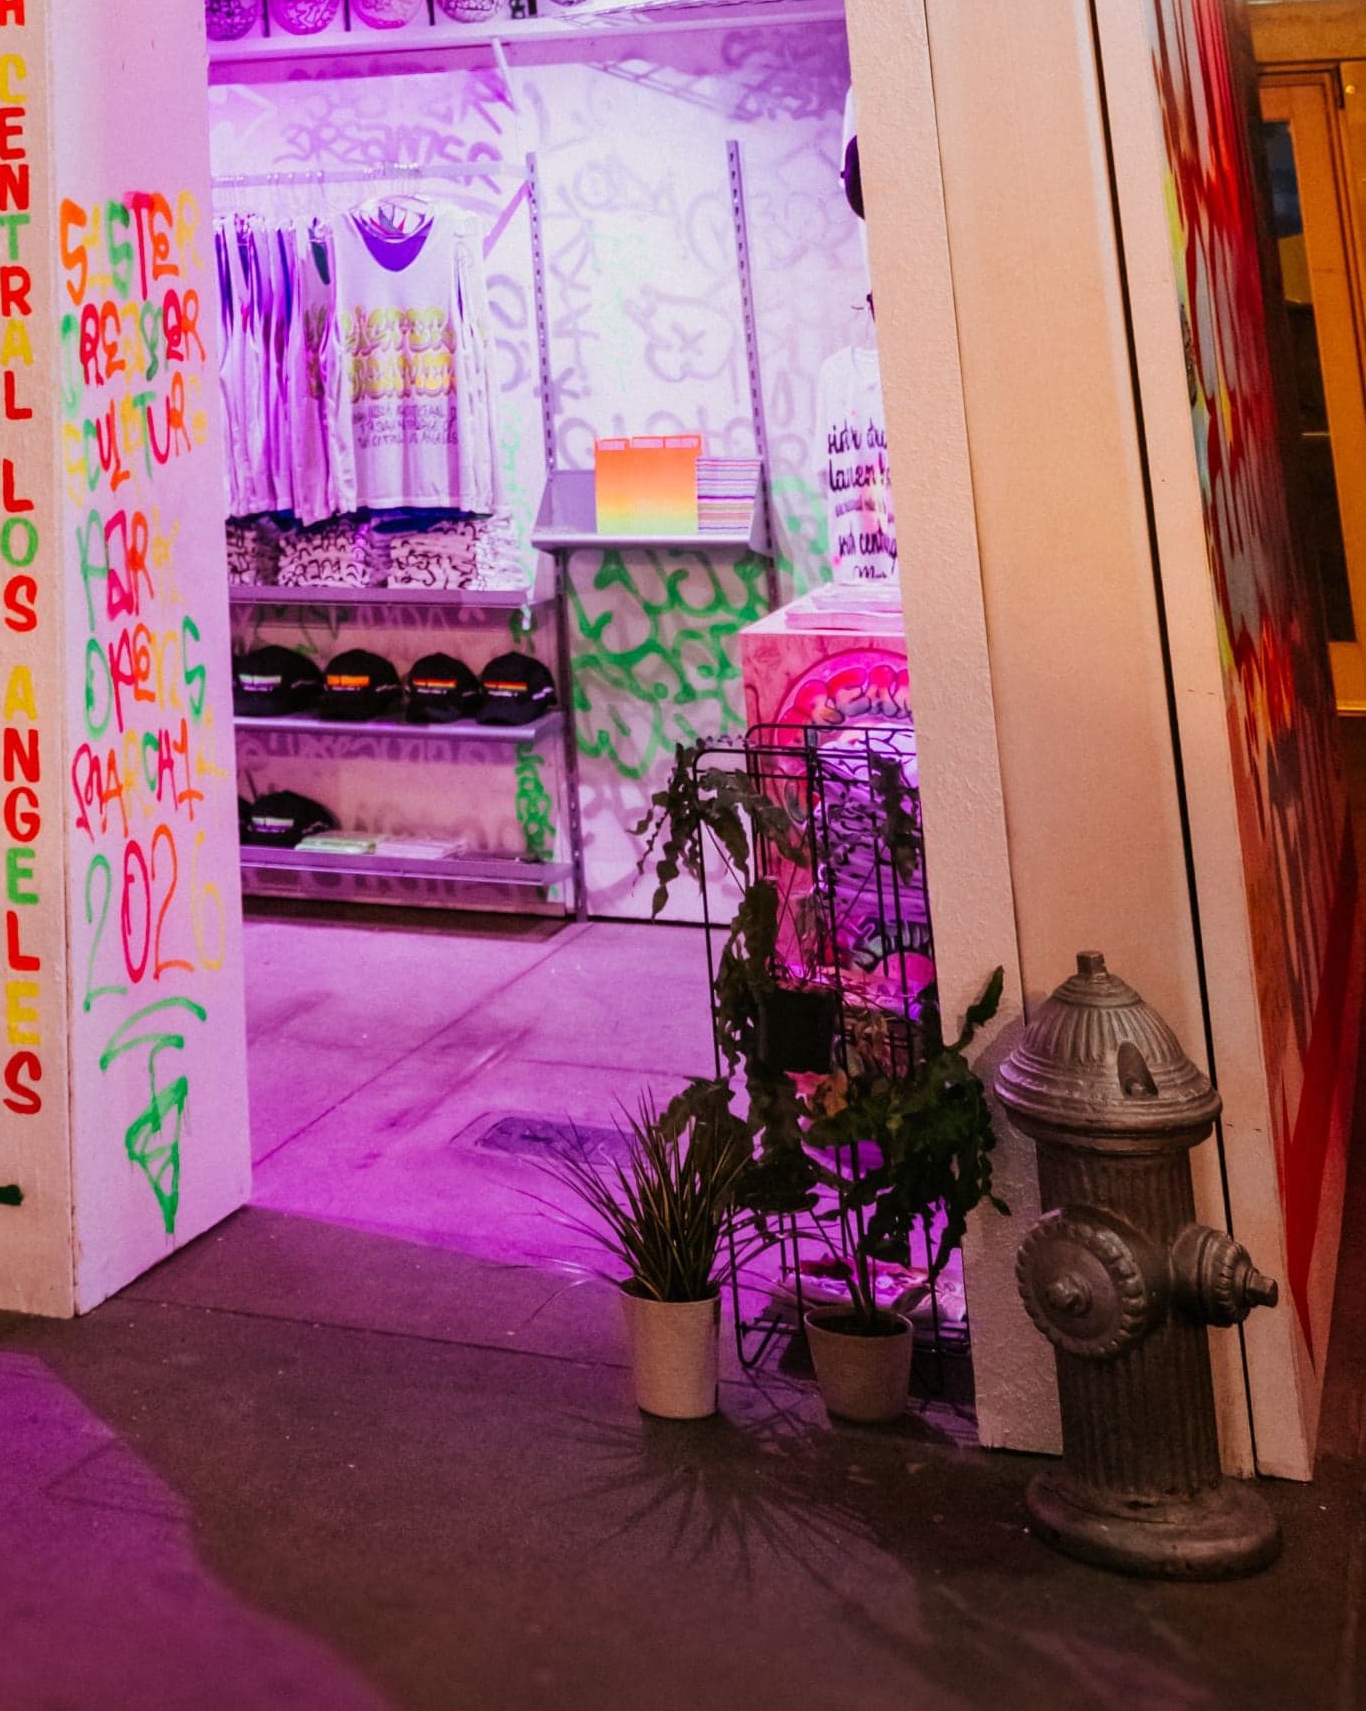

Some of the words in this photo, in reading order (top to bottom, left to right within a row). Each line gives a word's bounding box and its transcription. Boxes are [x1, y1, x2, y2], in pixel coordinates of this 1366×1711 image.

[60, 190, 204, 306] SISTER
[60, 289, 206, 419] DREAMER
[62, 371, 208, 509] SCULPTURE
[0, 457, 39, 633] LOS
[76, 503, 184, 632] PARK
[72, 728, 178, 844] MARCH
[3, 664, 43, 1115] ANGELES
[84, 823, 226, 1012] 2026
